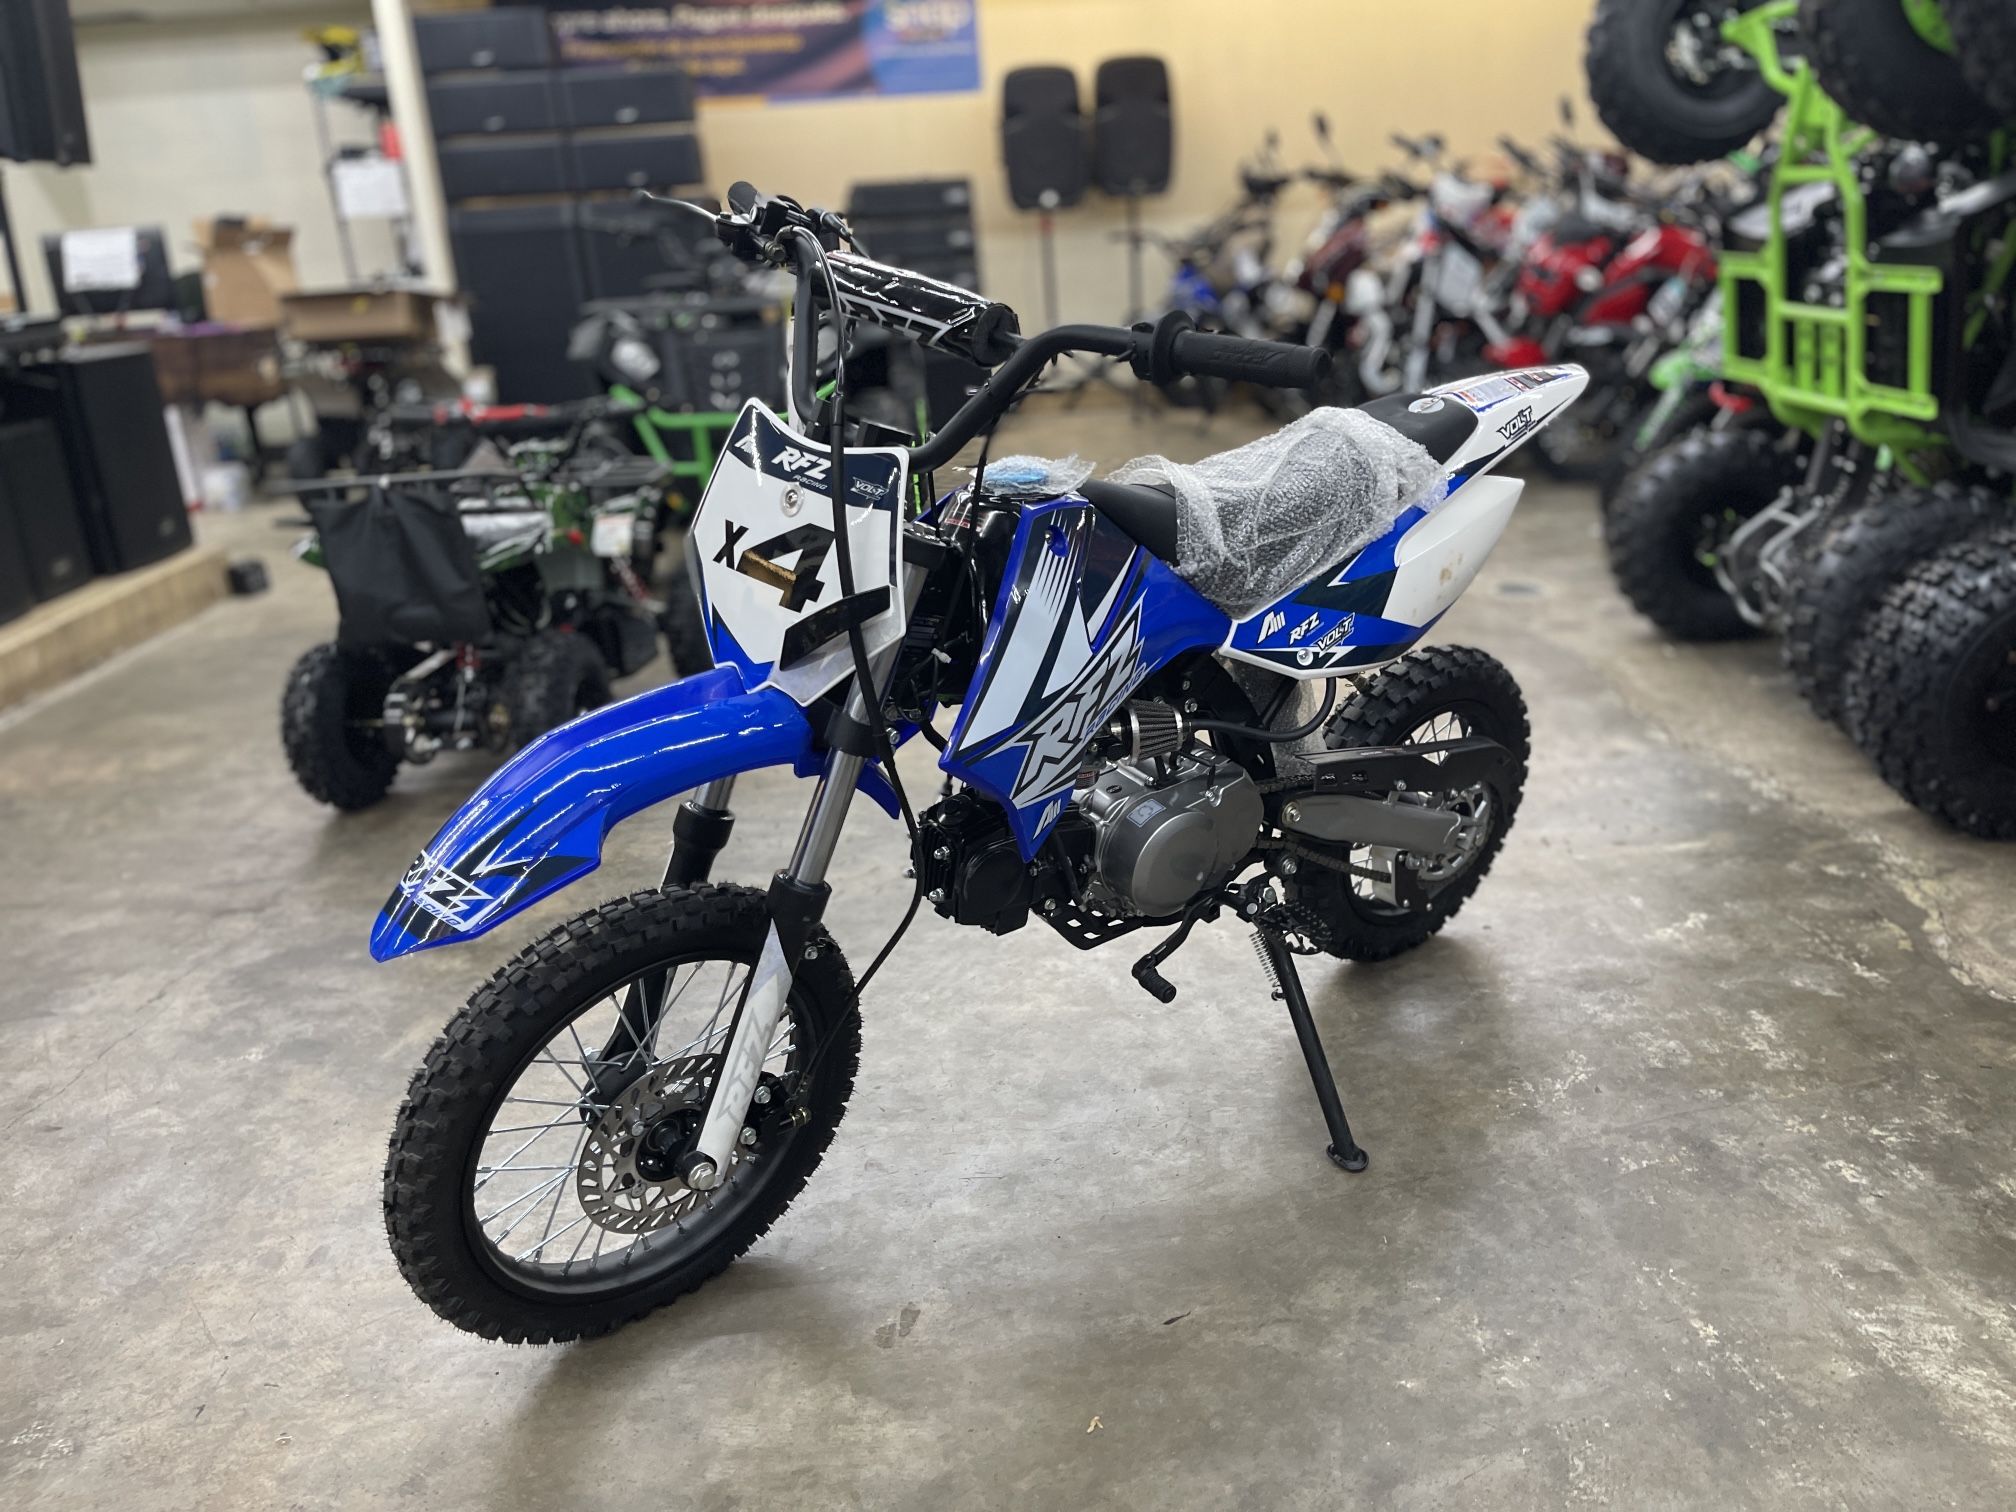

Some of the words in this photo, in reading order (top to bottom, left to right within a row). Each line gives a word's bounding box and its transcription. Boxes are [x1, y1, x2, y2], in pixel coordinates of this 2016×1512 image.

[1496, 405, 1532, 441] VOLT
[771, 445, 832, 480] RFZ
[852, 478, 887, 499] VOLT
[1289, 612, 1320, 645] RFZ
[1316, 616, 1353, 652] VOLT
[1021, 620, 1137, 788] RFZ
